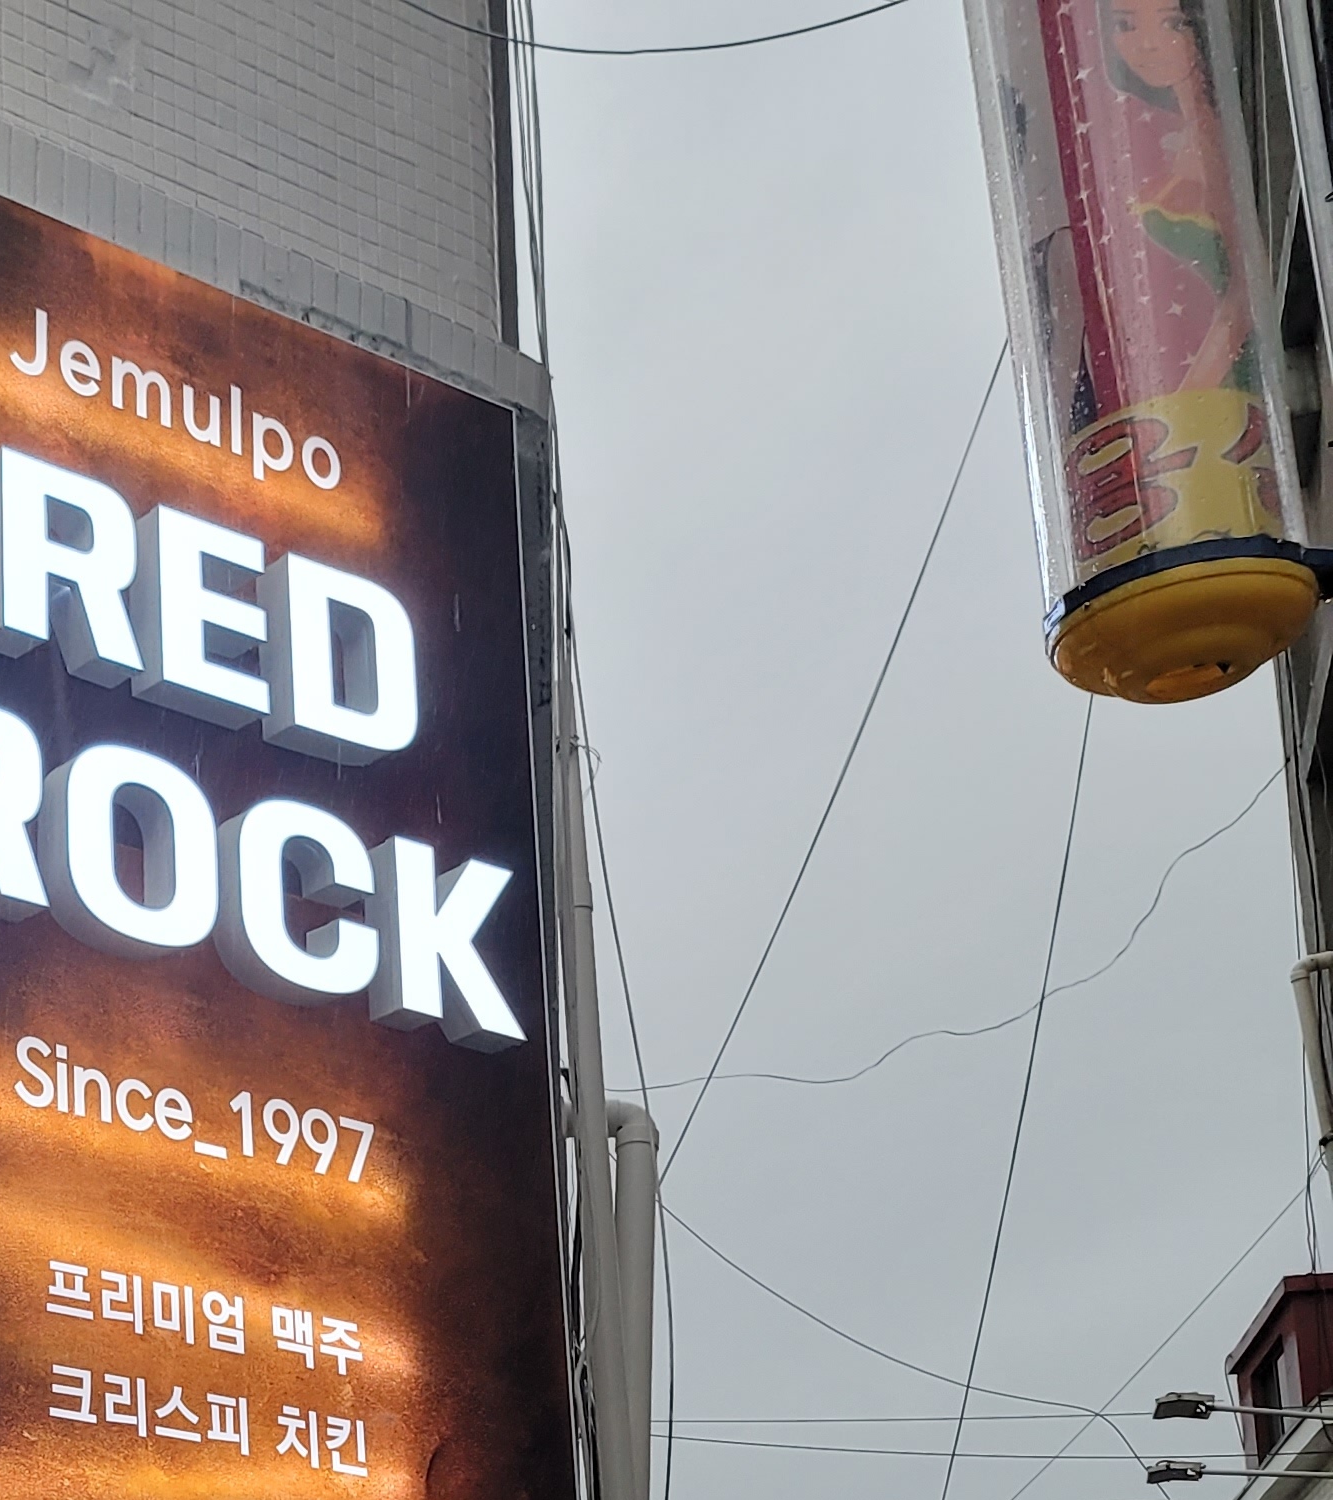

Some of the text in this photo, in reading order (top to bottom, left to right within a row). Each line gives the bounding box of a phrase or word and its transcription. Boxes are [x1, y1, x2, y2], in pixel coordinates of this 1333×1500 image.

[10, 308, 341, 489] Jemulpo
[14, 1035, 374, 1182] Since_1997
[46, 1260, 363, 1375] 프리미엄 맥주
[49, 1364, 368, 1477] 크리스피 치킨
